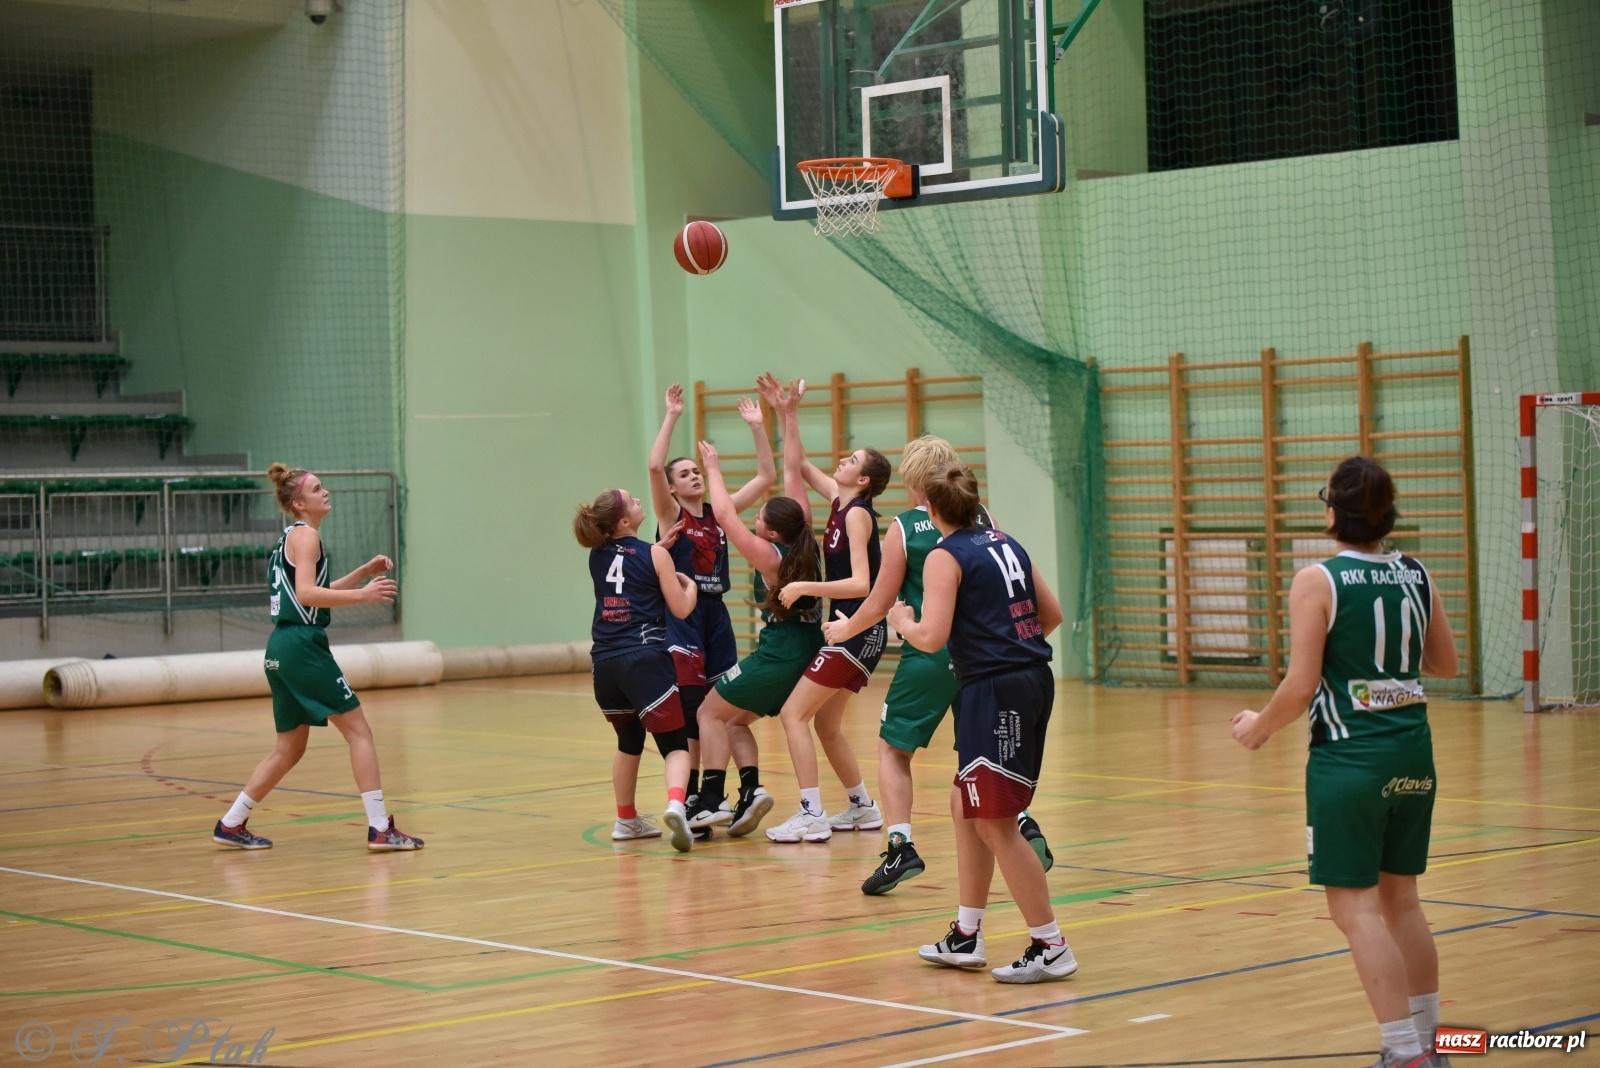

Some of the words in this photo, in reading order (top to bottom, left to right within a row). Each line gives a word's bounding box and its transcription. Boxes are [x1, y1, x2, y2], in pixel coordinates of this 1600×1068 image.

[914, 520, 935, 534] RKK
[829, 528, 841, 549] 9
[605, 554, 625, 594] 4
[987, 543, 1026, 599] 14
[1340, 569, 1367, 586] RKK
[1373, 596, 1412, 673] 11
[810, 656, 825, 672] 9
[1394, 776, 1433, 792] Clavis
[966, 783, 980, 808] 14
